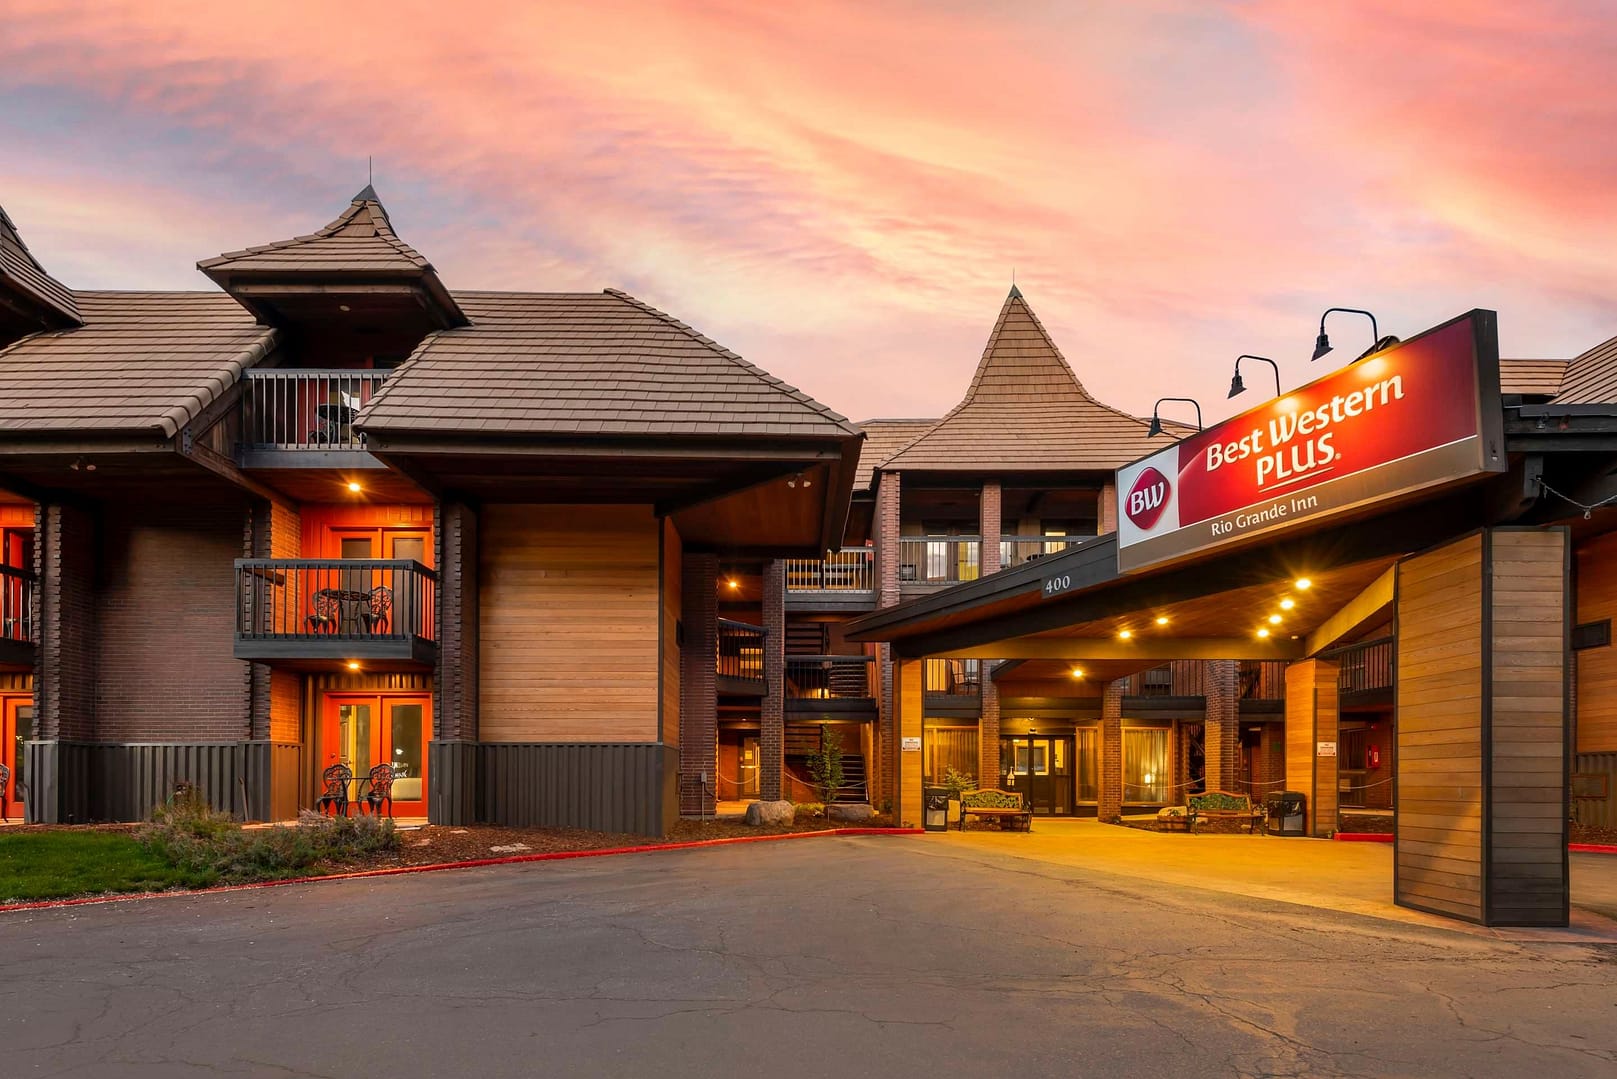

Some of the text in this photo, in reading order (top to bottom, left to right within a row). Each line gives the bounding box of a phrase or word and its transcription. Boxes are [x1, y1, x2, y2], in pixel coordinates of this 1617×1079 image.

[1206, 374, 1405, 472] Best Western
[1130, 481, 1165, 516] BW
[1211, 495, 1318, 537] Rio Grande Inn
[1045, 575, 1071, 594] 400
